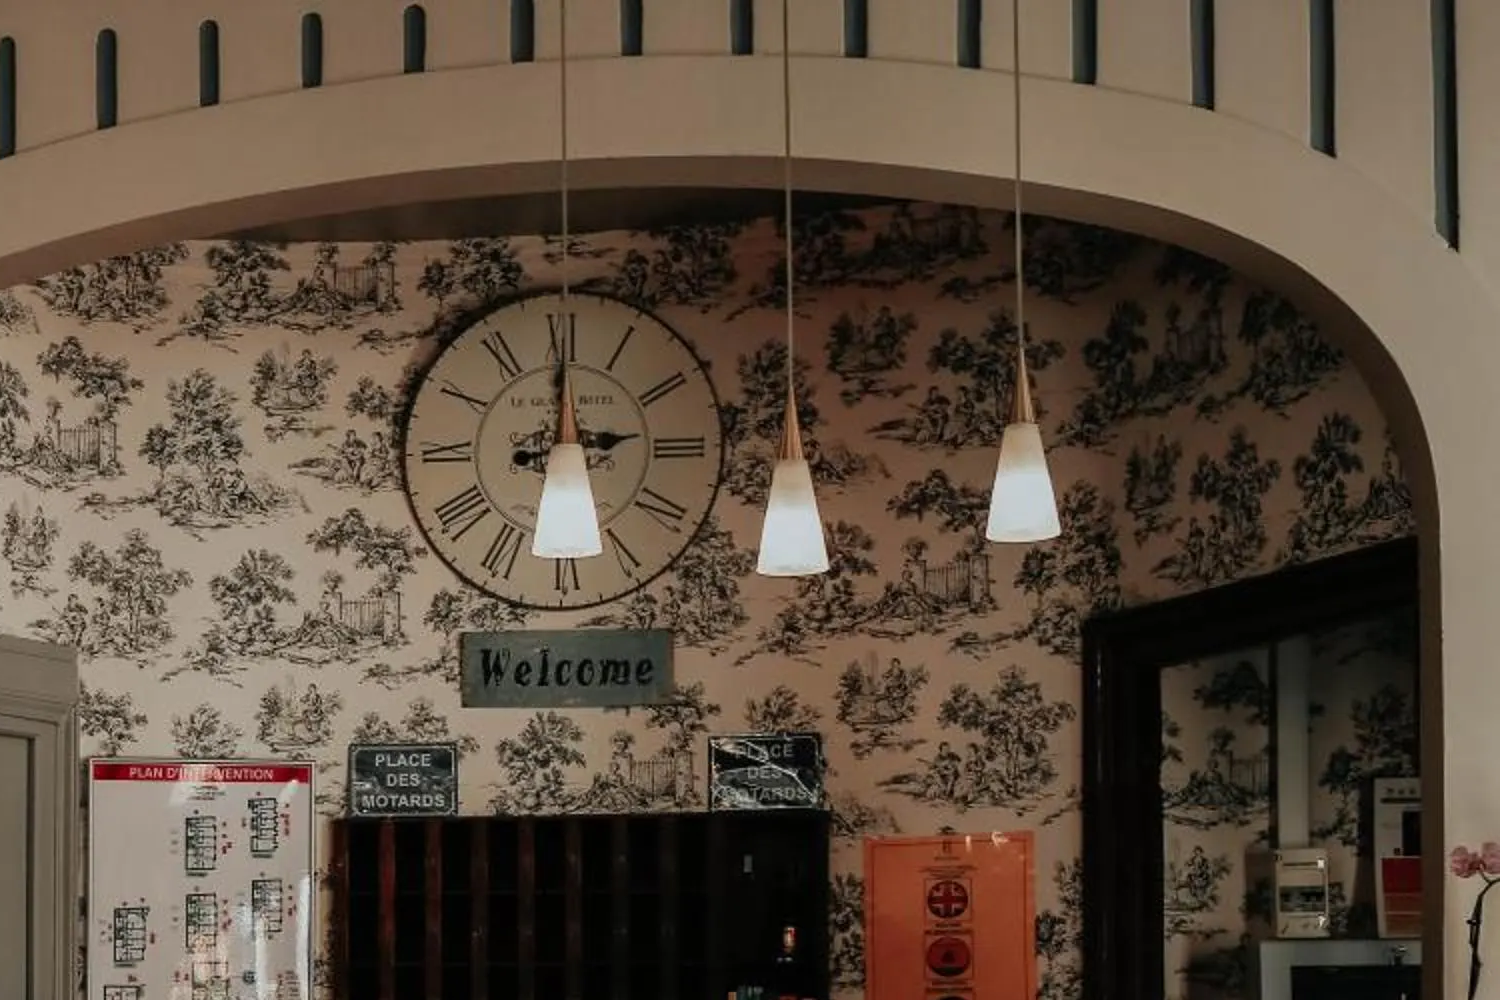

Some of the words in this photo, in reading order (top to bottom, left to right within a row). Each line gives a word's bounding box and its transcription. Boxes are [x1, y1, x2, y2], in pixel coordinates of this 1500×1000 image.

[653, 436, 706, 460] III
[480, 648, 654, 687] Welcome
[375, 753, 432, 768] PLACE
[129, 767, 163, 779] PLAN
[386, 773, 421, 787] DES
[747, 766, 782, 779] DES
[362, 793, 445, 808] MOTARDS
